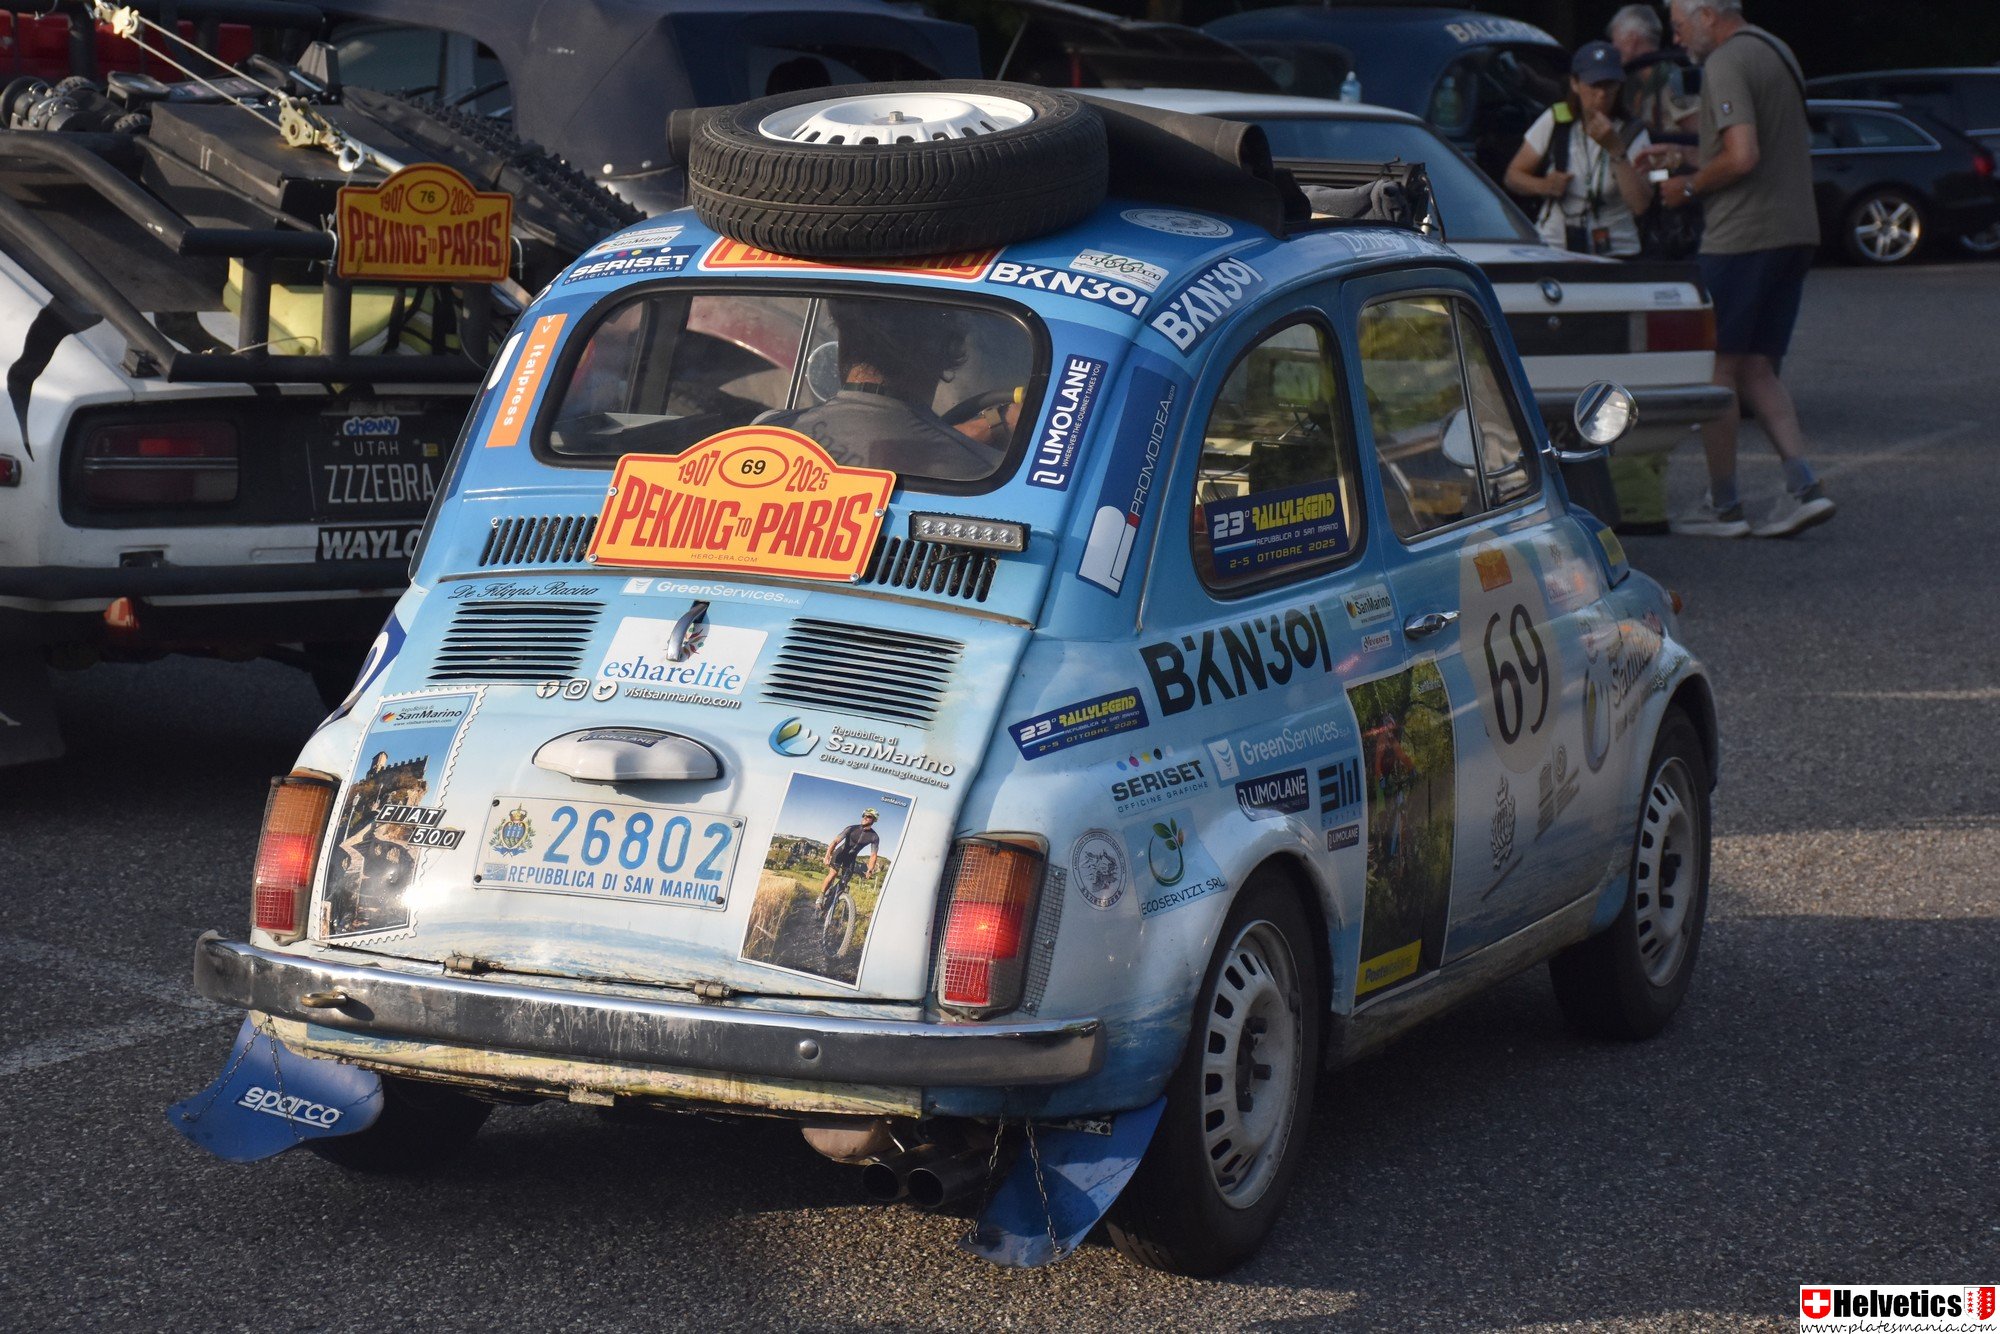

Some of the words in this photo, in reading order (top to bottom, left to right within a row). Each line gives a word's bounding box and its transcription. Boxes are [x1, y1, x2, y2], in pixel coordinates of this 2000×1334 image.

[380, 184, 405, 214] 1907
[420, 190, 435, 204] 76
[451, 187, 476, 216] 2025
[348, 205, 427, 265] PEKING
[428, 238, 438, 254] TO
[438, 211, 503, 267] PARIS
[564, 271, 616, 285] OFFICINE
[622, 265, 681, 275] GRAFICHE
[569, 254, 690, 279] SERISET
[503, 344, 546, 426] Italpress
[1086, 376, 1097, 395] TAKES
[1091, 363, 1102, 377] YOU
[1038, 358, 1092, 466] LIMOLANE
[1077, 394, 1090, 422] JOURNEY
[345, 417, 399, 434] chewy
[1072, 421, 1082, 434] THE
[353, 440, 400, 456] UTAH
[1061, 433, 1078, 467] WHEREVER
[324, 463, 436, 504] ZZZEBRA
[677, 450, 721, 487] 1907
[740, 459, 767, 476] 69
[784, 455, 830, 492] 2025
[606, 475, 741, 551] PEKING
[735, 516, 752, 538] TO
[747, 492, 873, 562] PARIS
[1252, 492, 1336, 532] RALLYLEGEND
[1256, 532, 1292, 546] REPUBBLICA
[1303, 527, 1316, 537] SAN
[1318, 522, 1339, 533] MARINO
[691, 552, 758, 564] HERO-ERA.COM
[1229, 556, 1250, 569] 2-5
[1257, 545, 1303, 563] OTTOBRE
[1308, 538, 1336, 552] 2025
[447, 584, 475, 599] De
[1354, 594, 1391, 615] SanMarino
[602, 653, 742, 692] esharelife
[1484, 604, 1549, 745] 69
[622, 684, 743, 710] visitsanmarino.com
[1059, 695, 1137, 726] RALLYLEGEND
[396, 708, 463, 721] SanMarino
[1114, 720, 1138, 730] 2025
[830, 724, 887, 743] Repubblica
[888, 736, 898, 746] di
[818, 753, 844, 765] Oltre
[846, 758, 869, 771] ogni
[871, 763, 949, 789] immaginazione
[825, 734, 955, 777] SanMarino
[1111, 760, 1206, 802] SERISET
[1248, 776, 1307, 808] LIMOLANE
[1118, 794, 1162, 813] OFFICINE
[1166, 781, 1209, 799] GRAFICHE
[380, 806, 439, 824] FIAT
[412, 827, 456, 847] 500
[542, 805, 733, 882] 26802
[507, 865, 595, 889] REPUBBLICA
[602, 872, 616, 891] DI
[623, 874, 653, 894] SAN
[659, 879, 720, 902] MARINO
[1141, 882, 1203, 916] ECOSERVIZI
[1206, 877, 1226, 892] SRL
[244, 1084, 343, 1126] sparco
